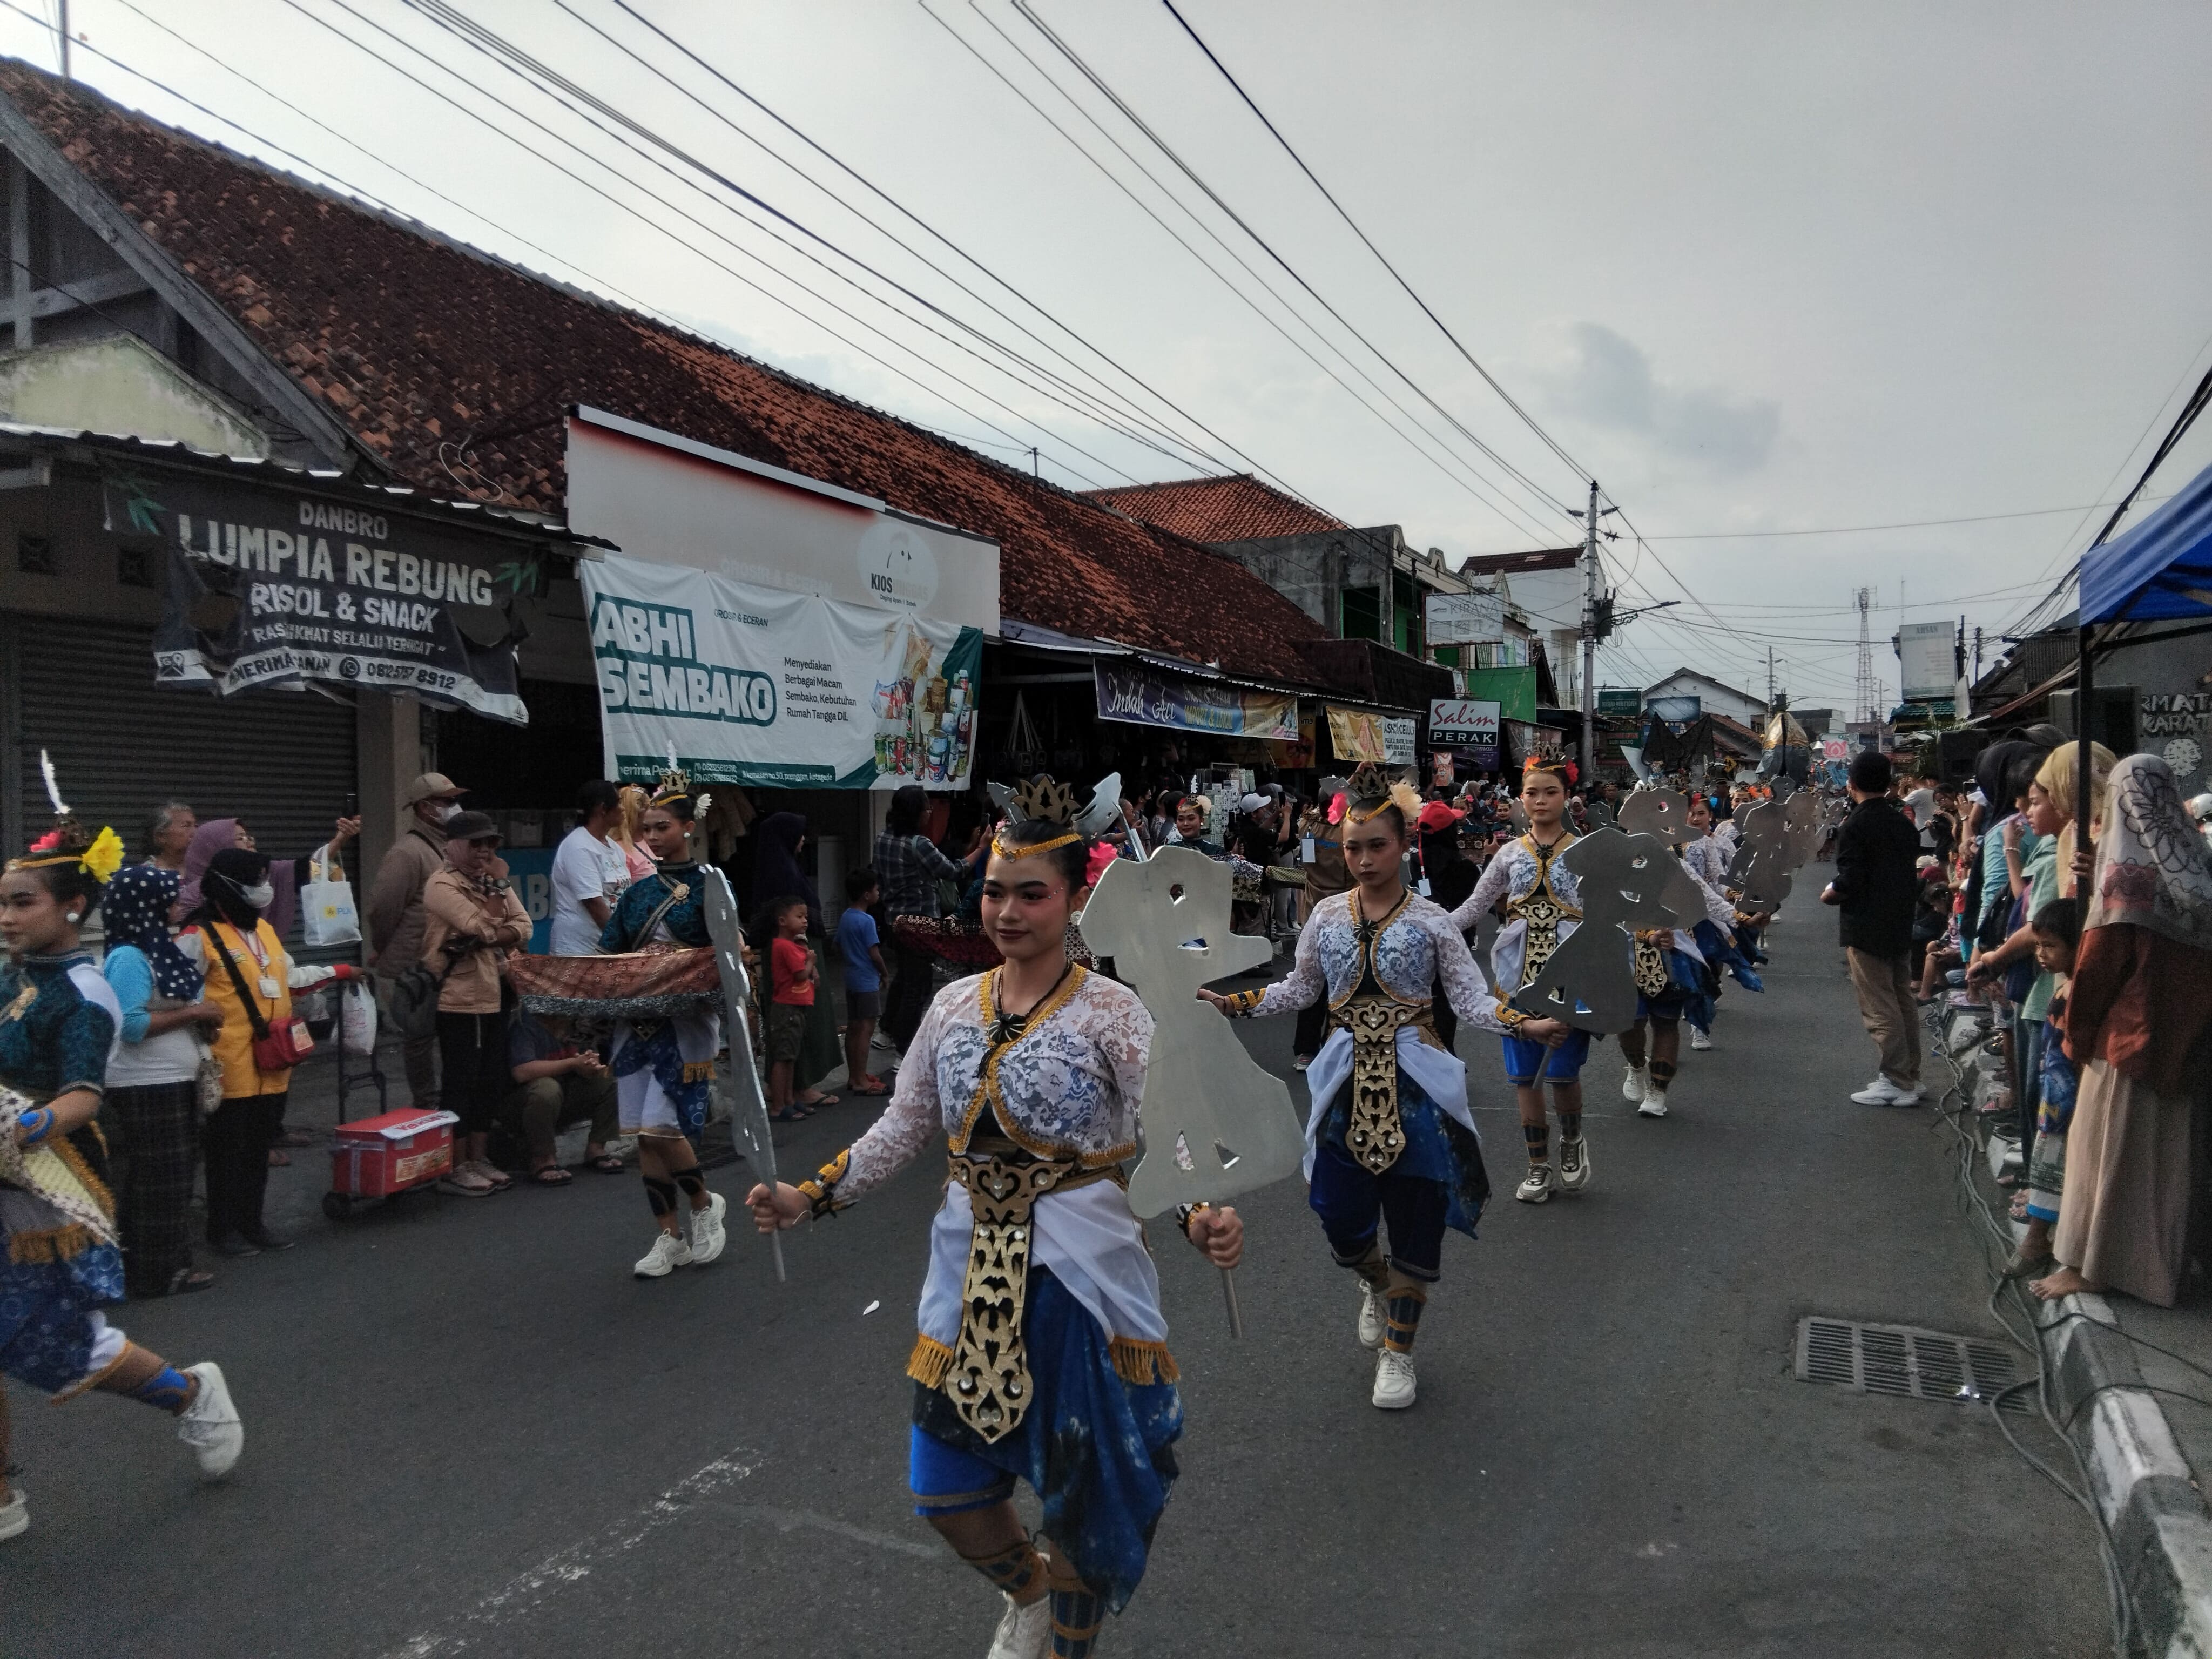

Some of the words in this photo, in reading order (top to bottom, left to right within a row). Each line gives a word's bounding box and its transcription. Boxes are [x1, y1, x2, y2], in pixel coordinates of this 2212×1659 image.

[299, 501, 388, 539] DANBRO
[179, 514, 334, 582] LUMPIA
[347, 543, 493, 606] REBUNG
[871, 573, 892, 593] KIOS
[251, 583, 329, 617] RISOL
[336, 592, 356, 622] &
[363, 598, 440, 632] SNACK
[1451, 602, 1499, 615] KIRANA
[714, 609, 737, 622] GROSIR
[738, 613, 743, 622] &
[743, 615, 768, 627] ECERAN
[593, 597, 694, 660] ABHI
[333, 630, 383, 650] SELALU
[784, 657, 832, 671] Menyediakan
[417, 669, 456, 690] 8912
[601, 655, 774, 721] SEMBAKO
[785, 673, 815, 688] Berbagai
[817, 677, 842, 689] Macam
[786, 690, 819, 704] Sembako,
[820, 693, 857, 706] Kebutuhan
[1107, 672, 1145, 719] Indah
[1152, 686, 1176, 723] Acc
[787, 707, 811, 718] Rumah
[812, 709, 836, 723] Tangga
[1433, 703, 1495, 726] Salim
[1433, 732, 1493, 743] PERAK
